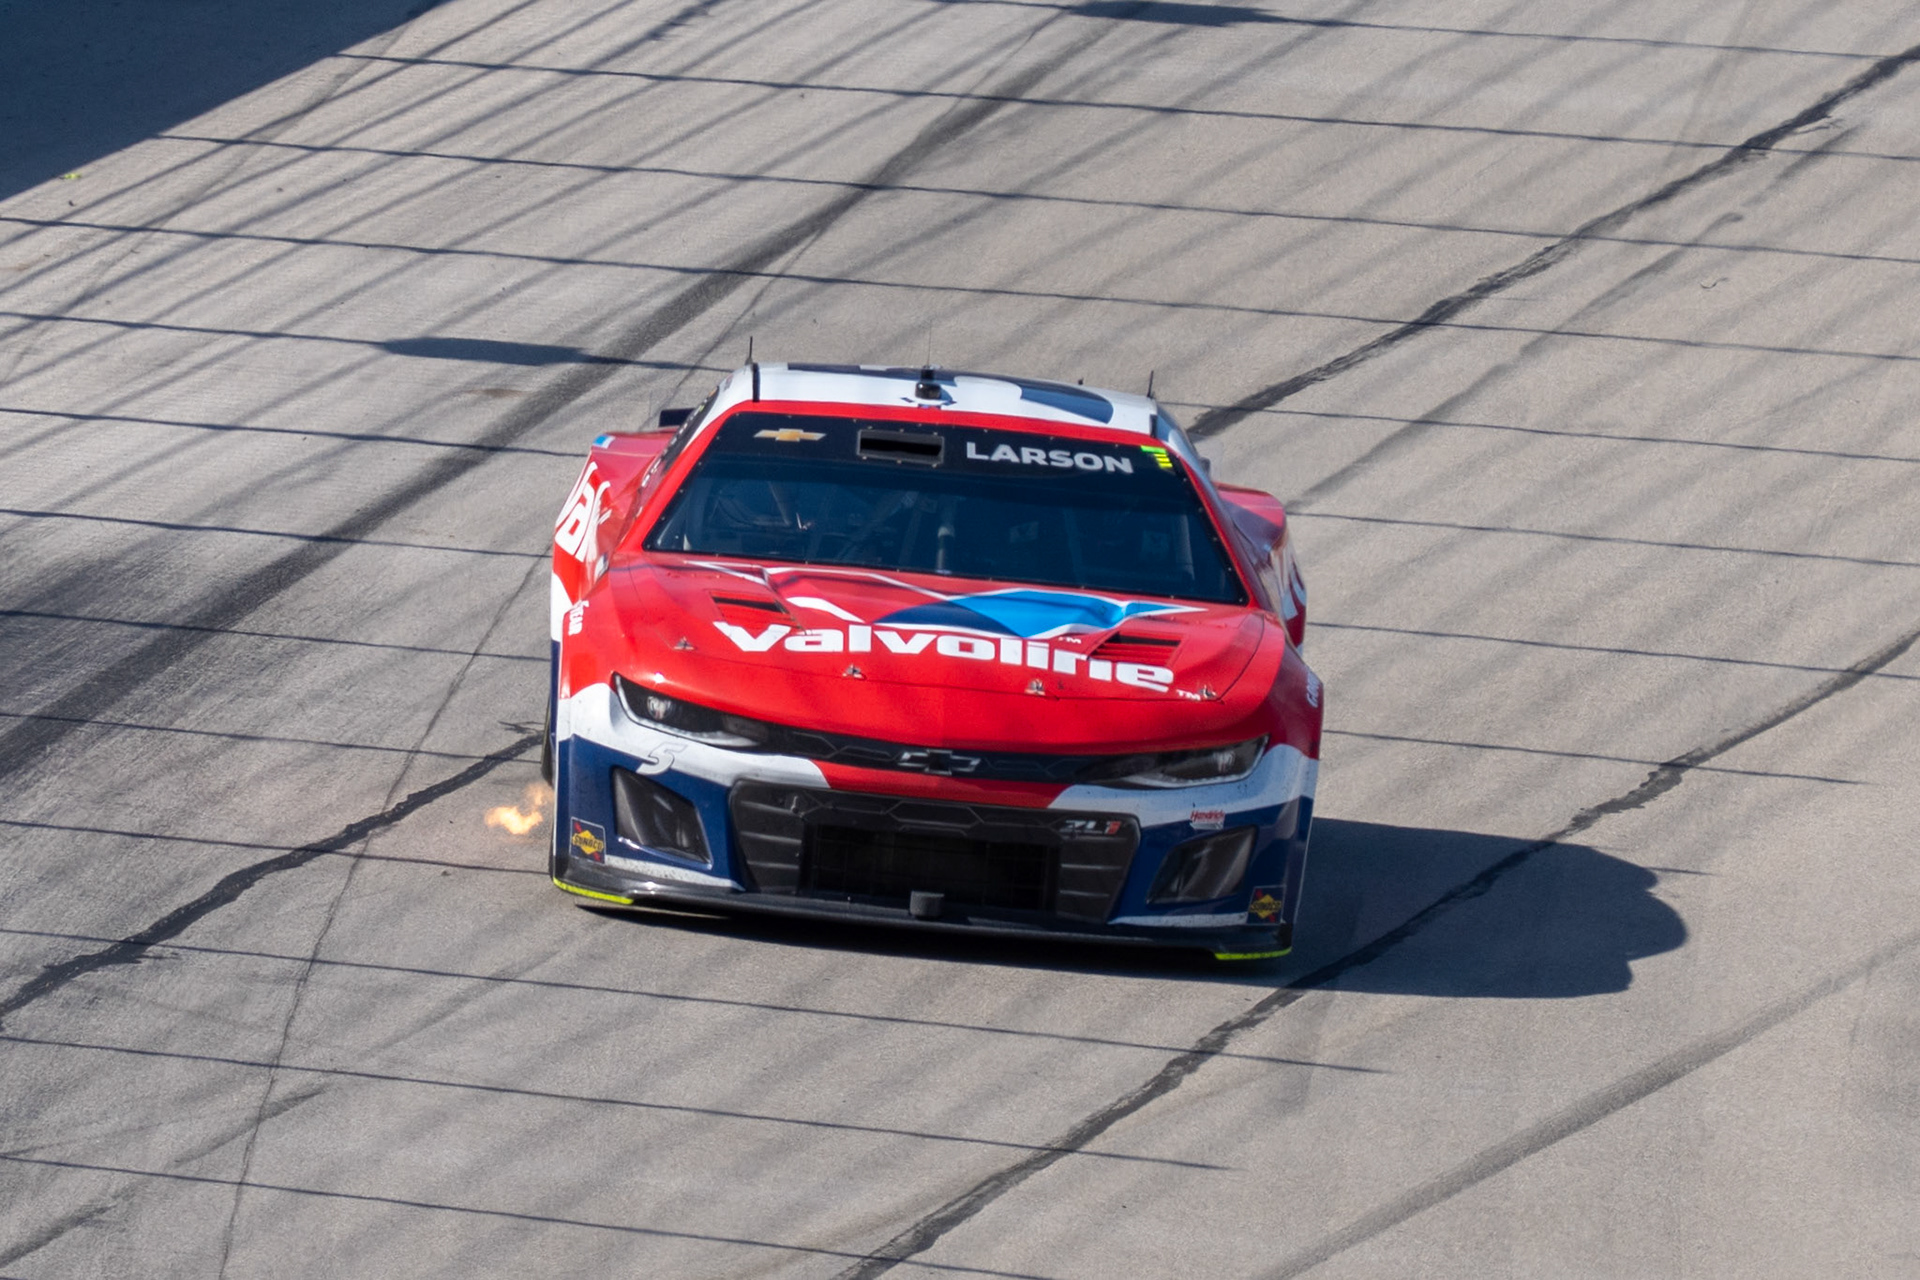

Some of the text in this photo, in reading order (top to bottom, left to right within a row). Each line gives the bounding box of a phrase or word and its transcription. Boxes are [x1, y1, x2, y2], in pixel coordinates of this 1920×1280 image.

[966, 441, 1134, 474] LARSON
[712, 621, 1174, 693] Valvoline
[635, 741, 688, 775] 5
[572, 834, 604, 851] SUNOCO
